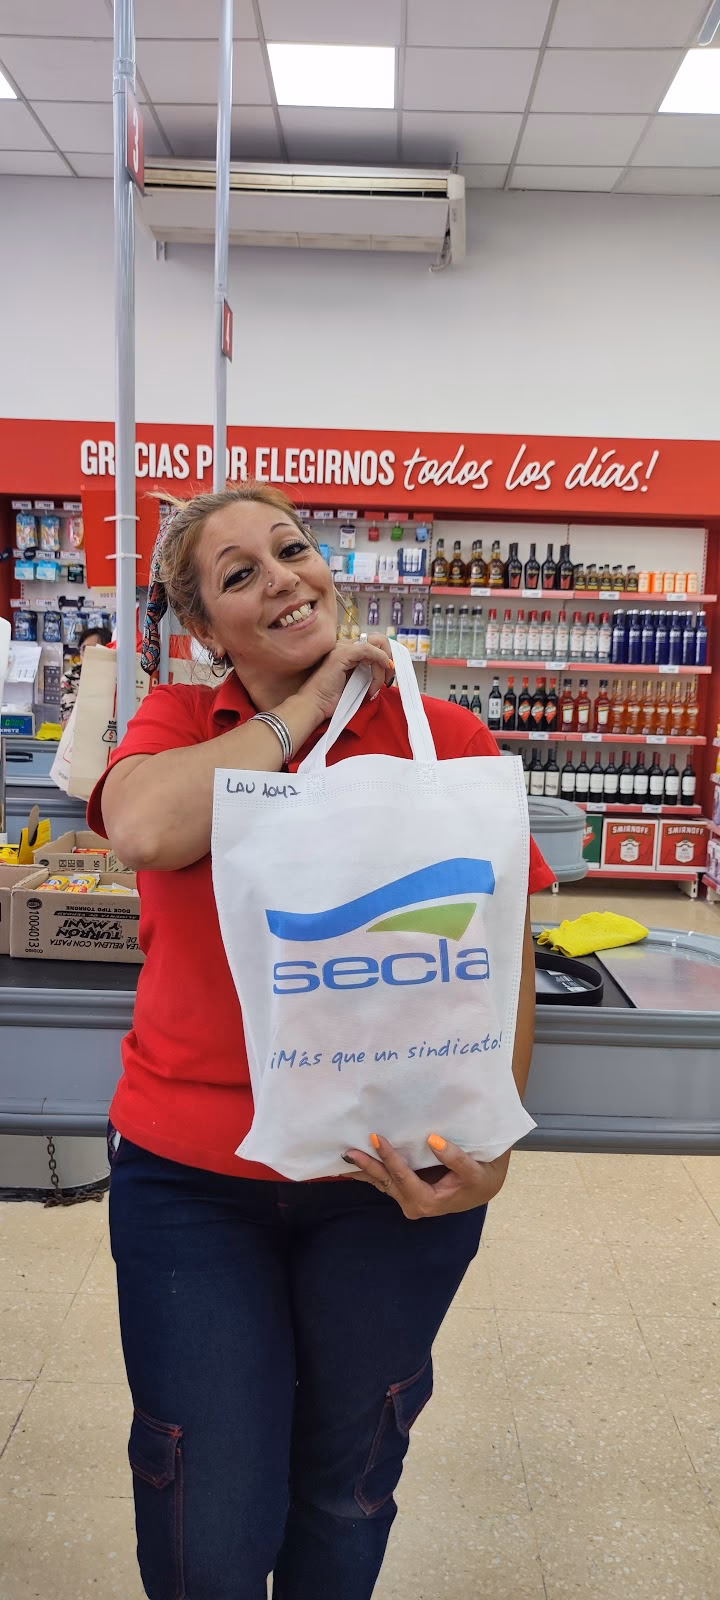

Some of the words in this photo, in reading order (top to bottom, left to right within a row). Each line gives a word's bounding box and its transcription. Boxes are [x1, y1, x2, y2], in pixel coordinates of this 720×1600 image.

[132, 107, 139, 173] 3
[225, 312, 230, 351] 4
[80, 439, 190, 480] GRCIAS
[255, 446, 396, 486] ELEGIRNOS
[403, 444, 493, 491] todos
[505, 443, 556, 491] los
[564, 446, 660, 492] días!
[226, 778, 255, 794] LAU
[612, 825, 649, 835] SMIRNOFF
[667, 826, 704, 836] SMIRNOFF
[28, 910, 40, 948] 1004013
[109, 921, 121, 931] Y
[50, 938, 72, 946] PASTA
[73, 940, 92, 948] CON
[94, 941, 125, 949] RELLENA
[126, 936, 137, 944] DE
[272, 938, 491, 995] secla
[270, 1049, 323, 1069] ¡Más
[331, 1051, 366, 1071] que
[374, 1050, 399, 1062] un
[407, 1031, 503, 1060] sindicato!
